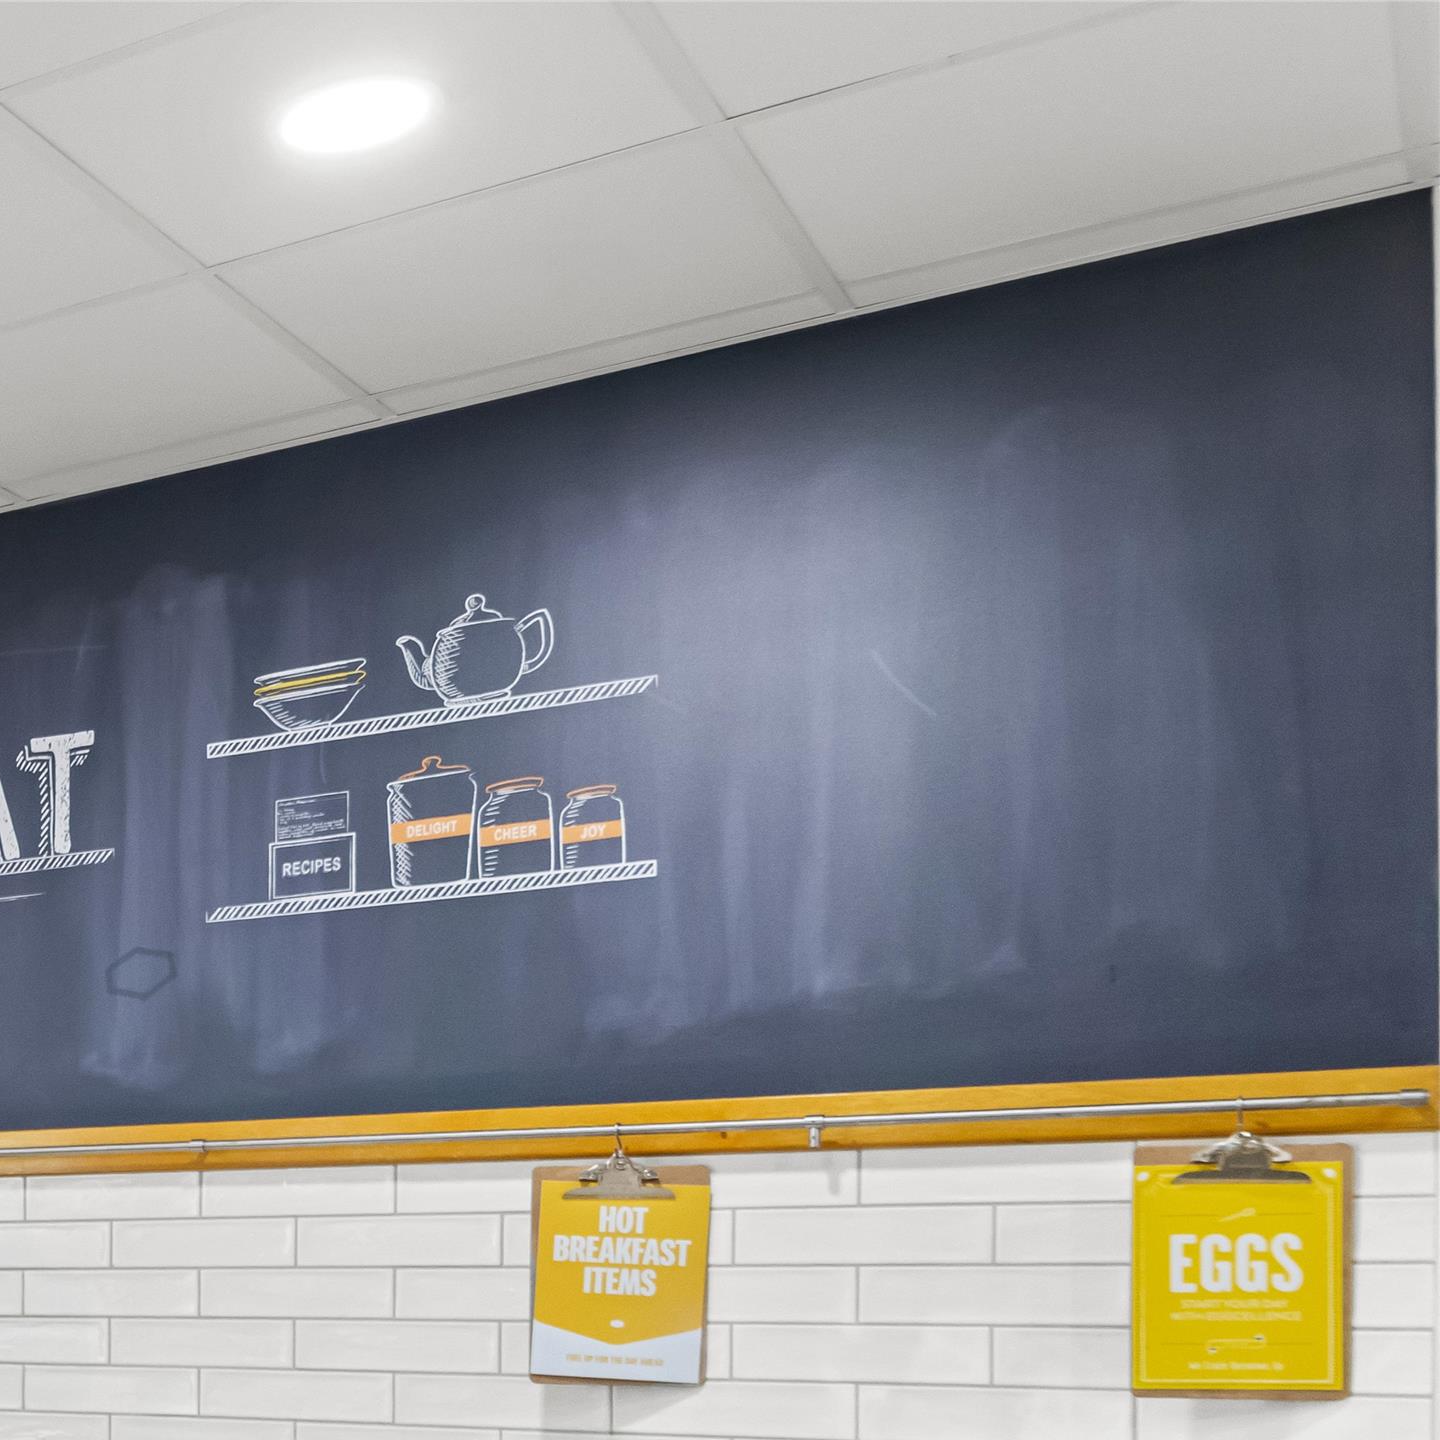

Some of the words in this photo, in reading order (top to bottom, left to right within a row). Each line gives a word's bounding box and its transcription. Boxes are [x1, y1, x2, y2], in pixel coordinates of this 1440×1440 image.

[406, 820, 458, 838] DELIGHT
[494, 824, 537, 842] CHEER
[580, 824, 606, 839] JOY
[282, 857, 342, 877] RECIPES
[598, 1205, 649, 1234] HOT
[552, 1234, 692, 1267] BREAKFAST
[1168, 1232, 1304, 1293] EGGS
[582, 1266, 657, 1296] ITEMS
